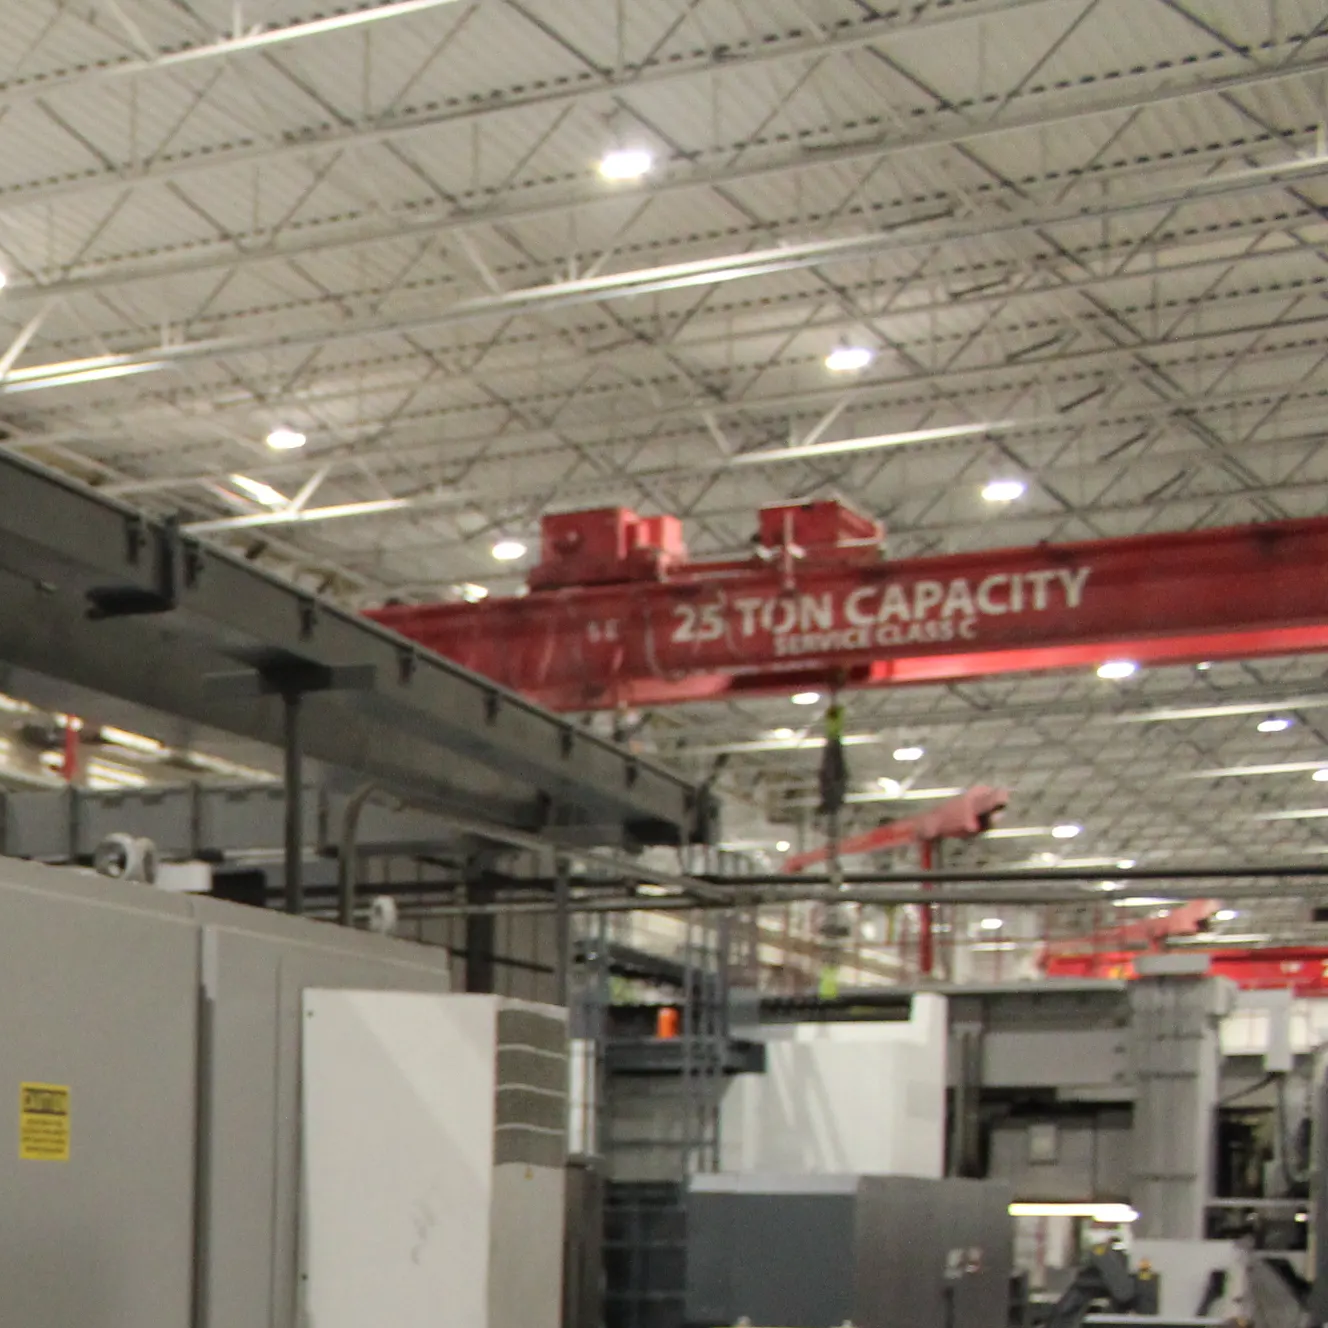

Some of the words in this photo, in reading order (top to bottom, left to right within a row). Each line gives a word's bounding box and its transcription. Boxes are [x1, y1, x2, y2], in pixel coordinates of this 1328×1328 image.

[671, 601, 726, 643] 25
[734, 593, 834, 637] TON
[846, 568, 1090, 626] CAPACITY
[773, 626, 871, 657] SERVICE
[875, 619, 953, 646] CLASS
[958, 617, 979, 640] C
